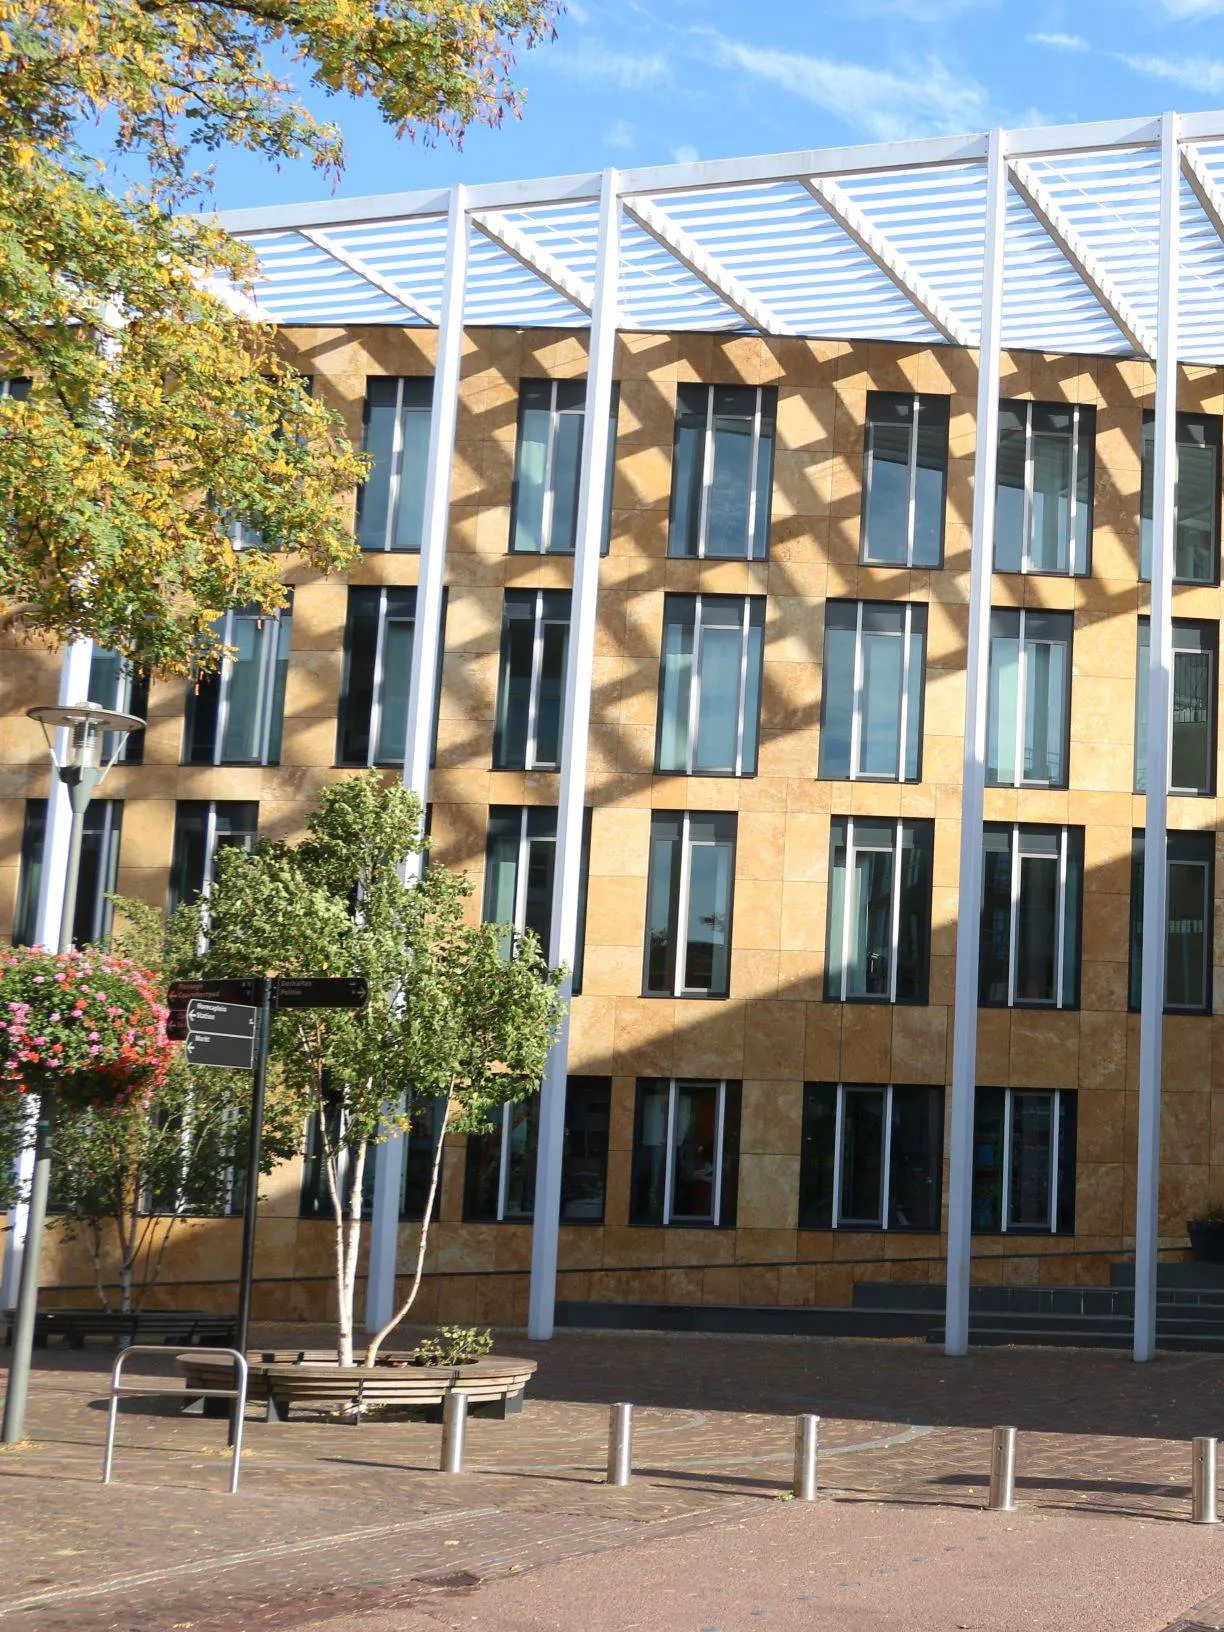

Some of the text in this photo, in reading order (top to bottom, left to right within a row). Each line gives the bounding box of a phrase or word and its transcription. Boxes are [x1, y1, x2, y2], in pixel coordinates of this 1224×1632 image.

[197, 1003, 227, 1012] Horecaplein
[196, 1012, 215, 1020] Station
[195, 1035, 210, 1043] Markt
